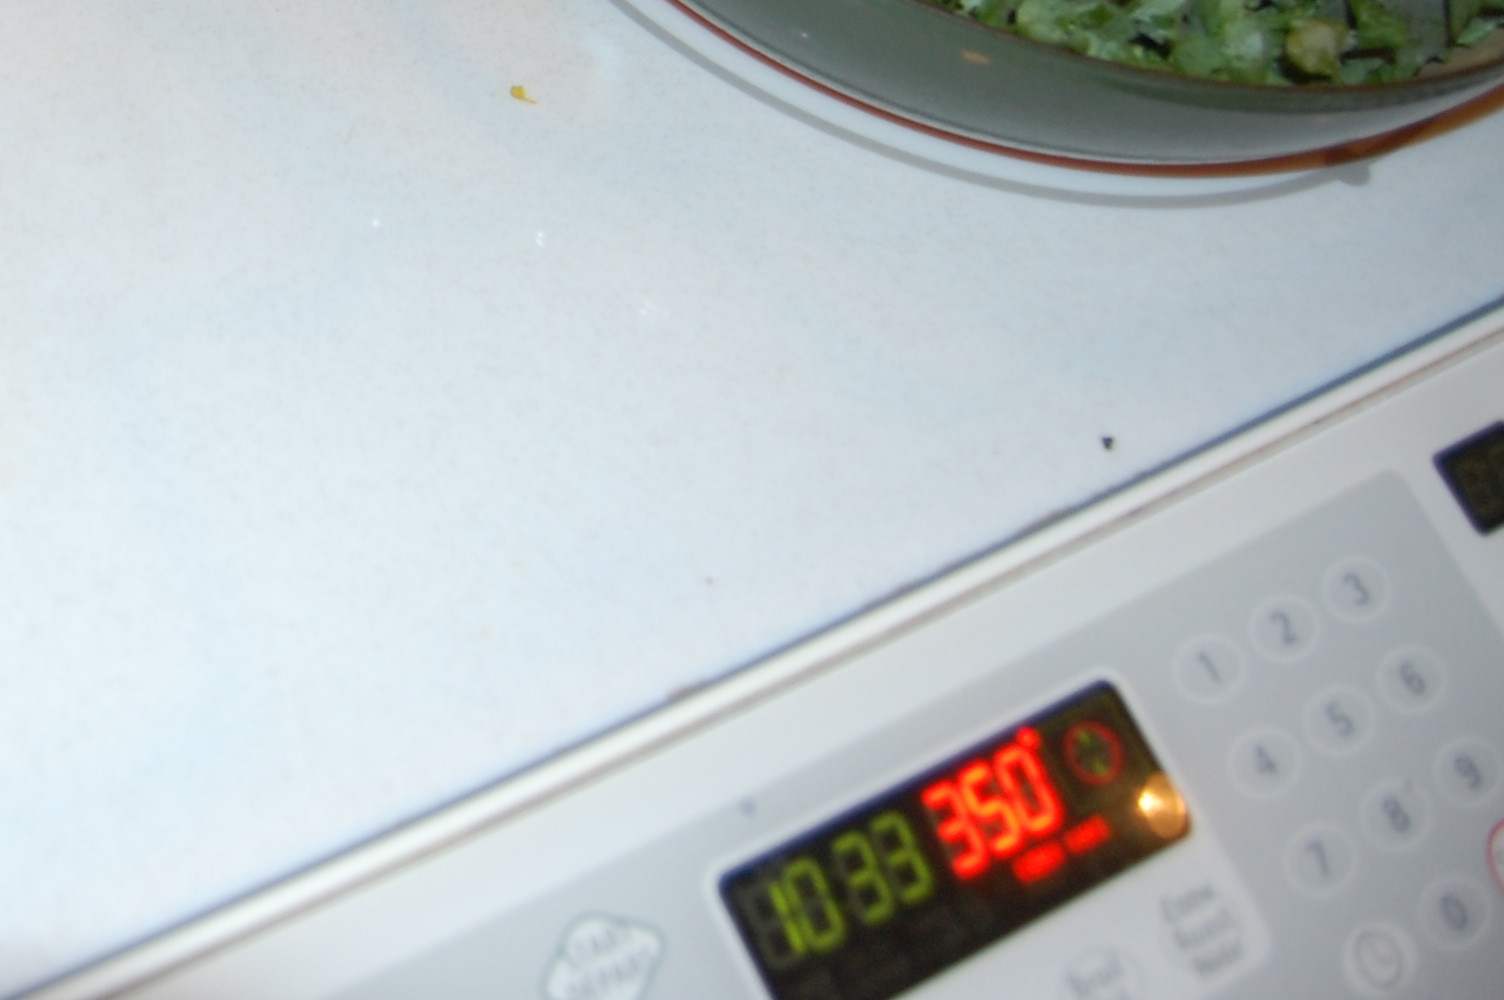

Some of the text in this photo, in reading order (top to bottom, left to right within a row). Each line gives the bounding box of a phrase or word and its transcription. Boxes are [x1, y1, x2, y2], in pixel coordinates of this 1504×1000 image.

[1343, 572, 1370, 606] 3
[1270, 610, 1298, 647] 2
[1197, 651, 1222, 685] 1
[1325, 700, 1356, 739] 5
[1305, 838, 1332, 879] 7
